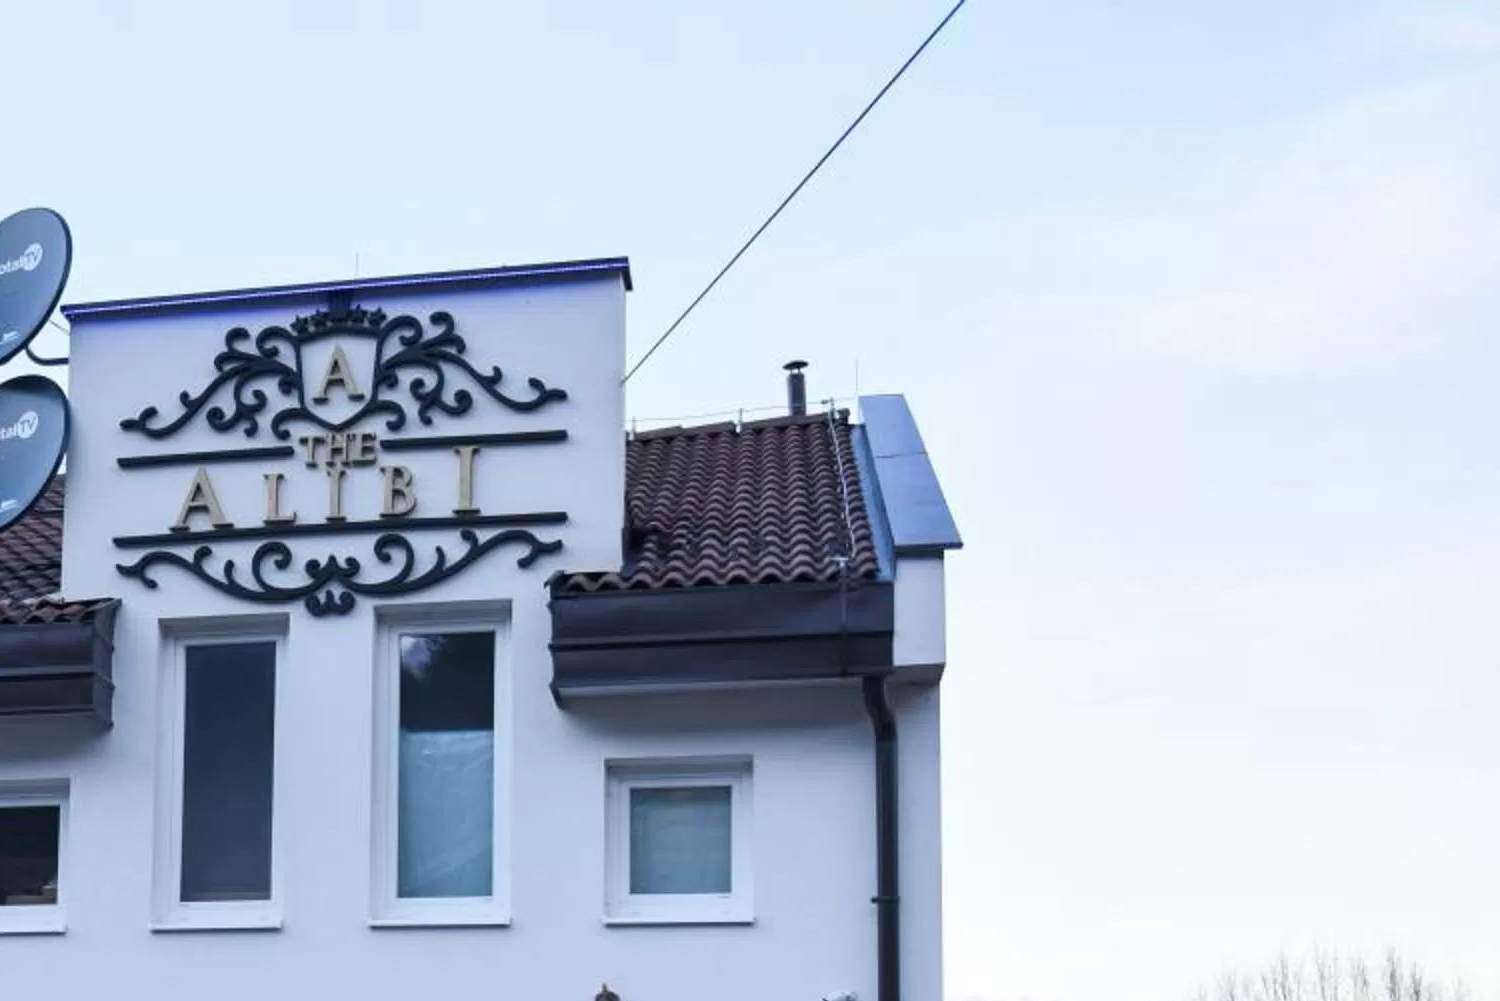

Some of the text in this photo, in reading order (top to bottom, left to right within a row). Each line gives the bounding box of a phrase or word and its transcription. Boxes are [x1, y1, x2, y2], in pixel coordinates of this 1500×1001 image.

[312, 344, 365, 404] A
[298, 431, 378, 470] THE
[169, 445, 482, 534] ALIBI
